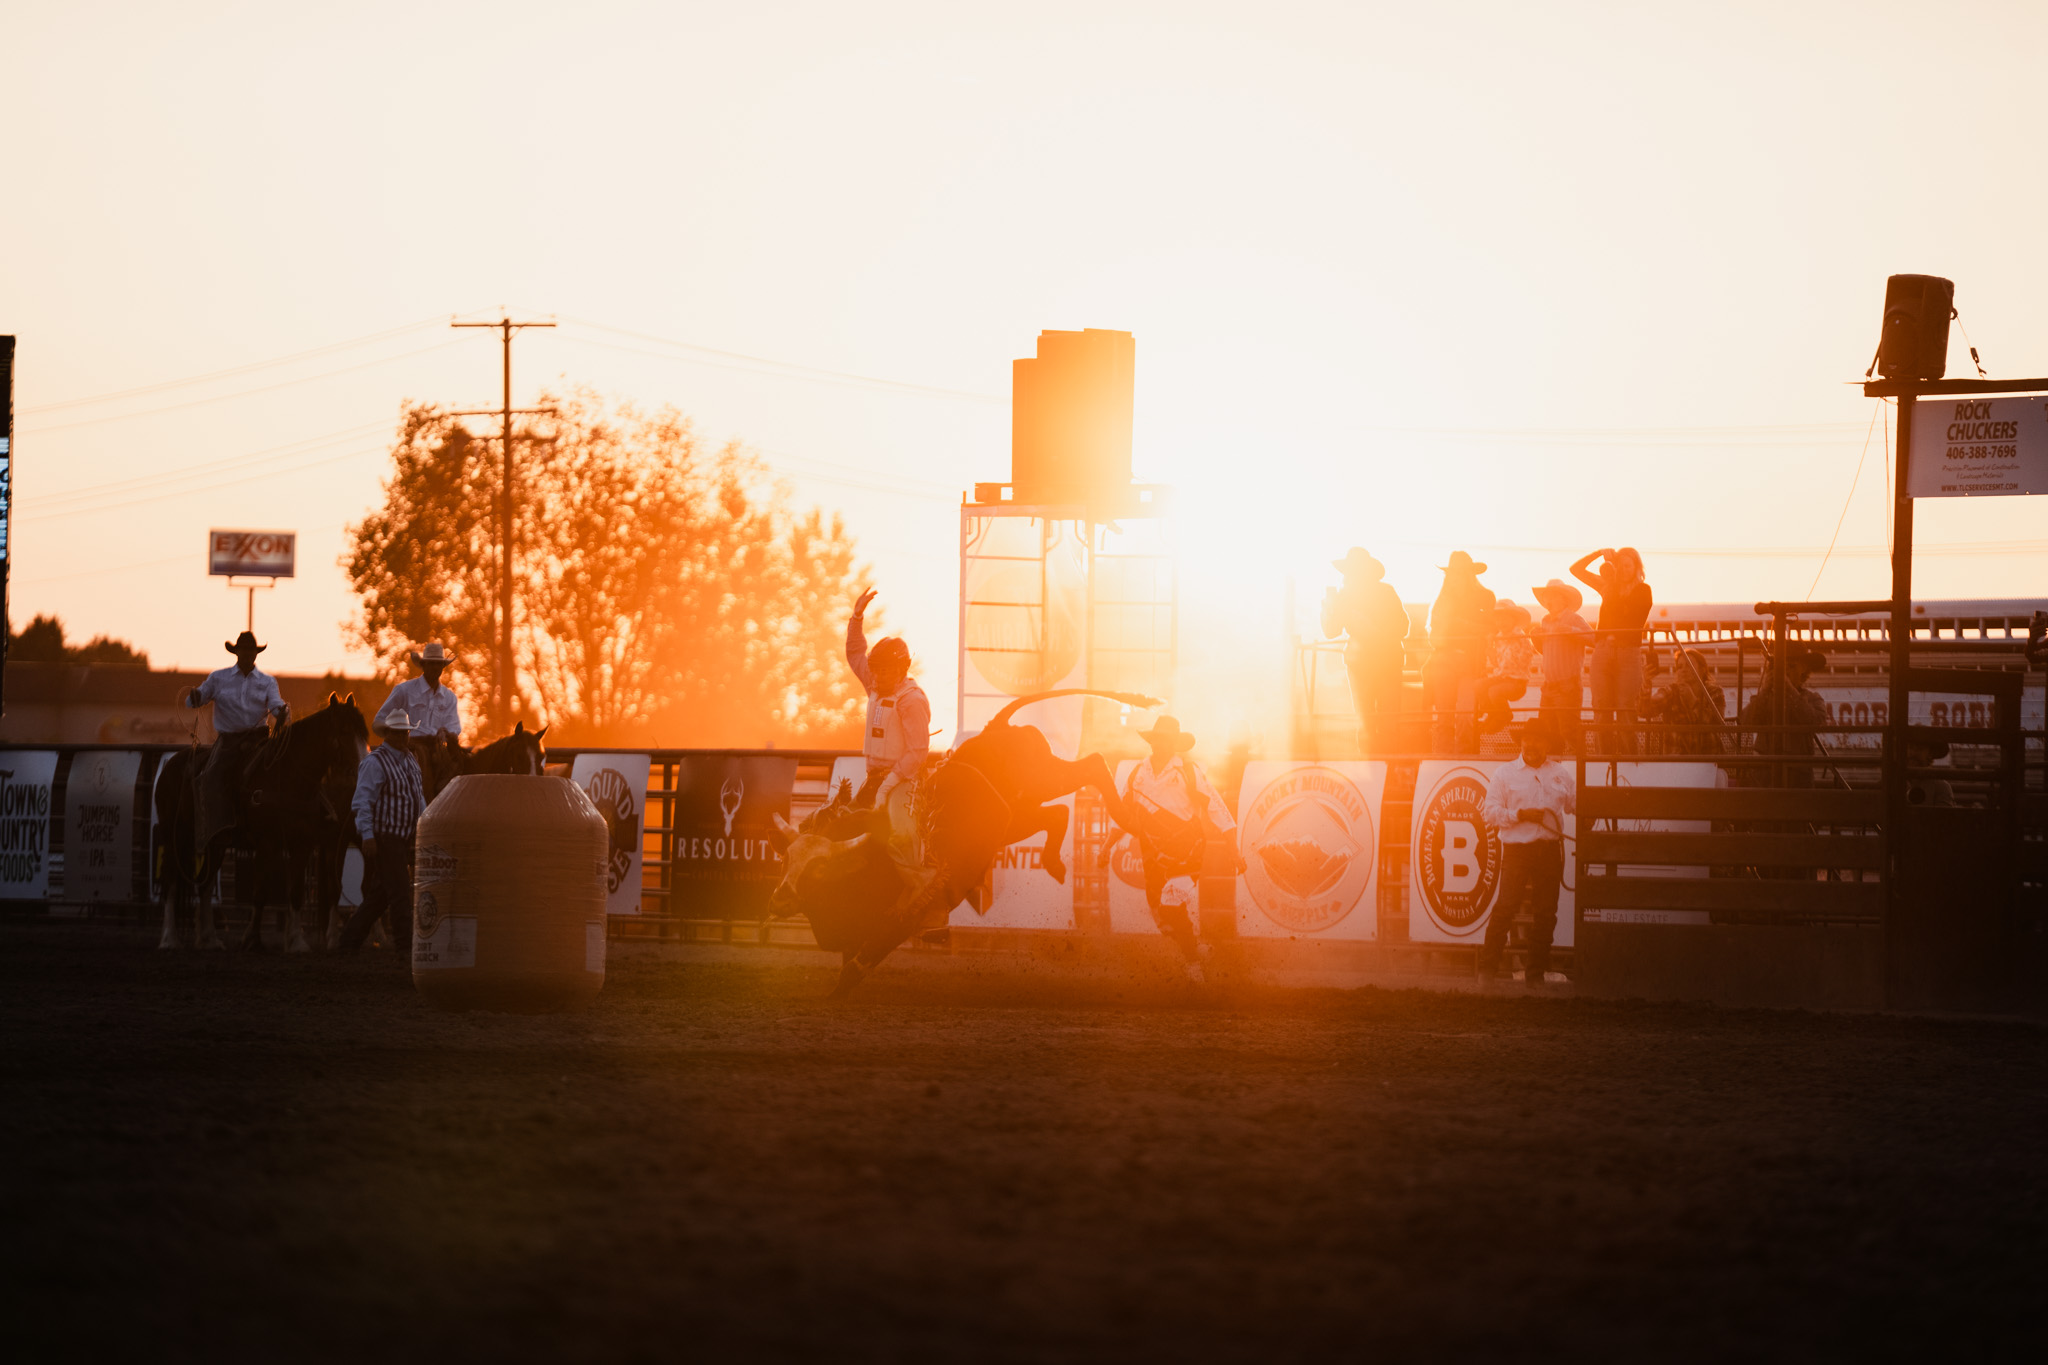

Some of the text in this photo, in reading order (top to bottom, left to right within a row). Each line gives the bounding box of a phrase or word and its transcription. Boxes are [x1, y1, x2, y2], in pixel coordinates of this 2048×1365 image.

[1954, 402, 1992, 420] ROCK
[1947, 421, 2018, 441] CHUCKERS
[1946, 445, 2017, 459] 406-388-7696
[216, 533, 290, 560] EXXON
[586, 772, 632, 819] OUND
[1256, 775, 1363, 822] ROCKY MOUNTAIN
[78, 805, 120, 829] JUMPING
[0, 819, 46, 862] UNTRY
[82, 824, 114, 842] HORSE
[1424, 807, 1441, 886] BOZEMAN
[1440, 786, 1476, 810] SPIRITS
[89, 848, 105, 867] IPA
[1441, 820, 1481, 893] B
[1280, 903, 1329, 924] SUPPLY
[1443, 904, 1475, 919] MONTANA
[1606, 912, 1669, 924] REAL ESTATE
